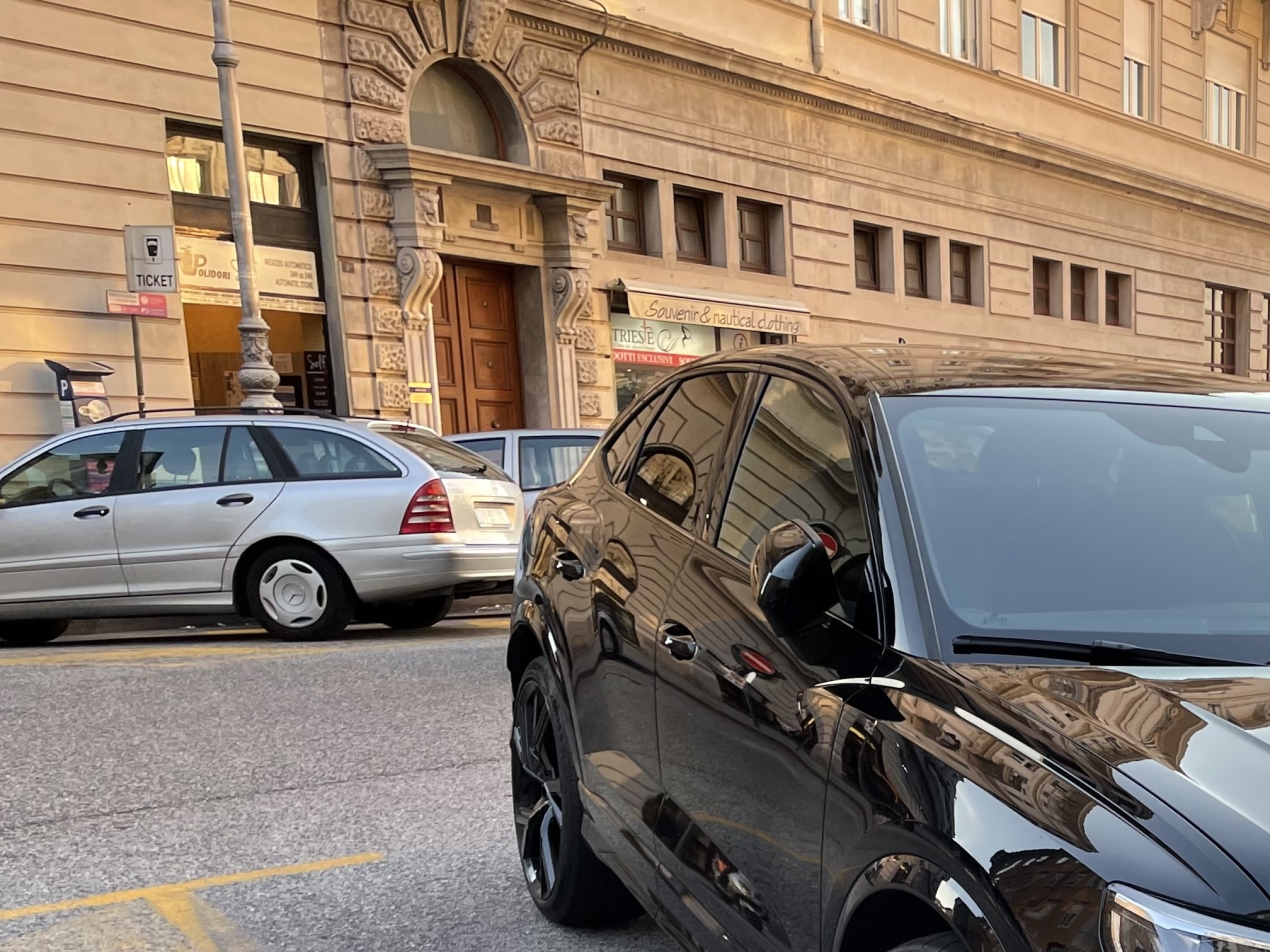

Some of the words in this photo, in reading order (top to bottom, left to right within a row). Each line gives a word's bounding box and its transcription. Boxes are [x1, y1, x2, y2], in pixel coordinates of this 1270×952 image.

[136, 274, 173, 287] TICKET
[645, 300, 699, 323] Souvenir
[700, 306, 712, 324] &
[713, 310, 756, 330] nautical
[757, 313, 800, 335] clothing
[306, 354, 327, 370] Self
[637, 353, 673, 365] ESCLUSIVI
[60, 379, 69, 397] P
